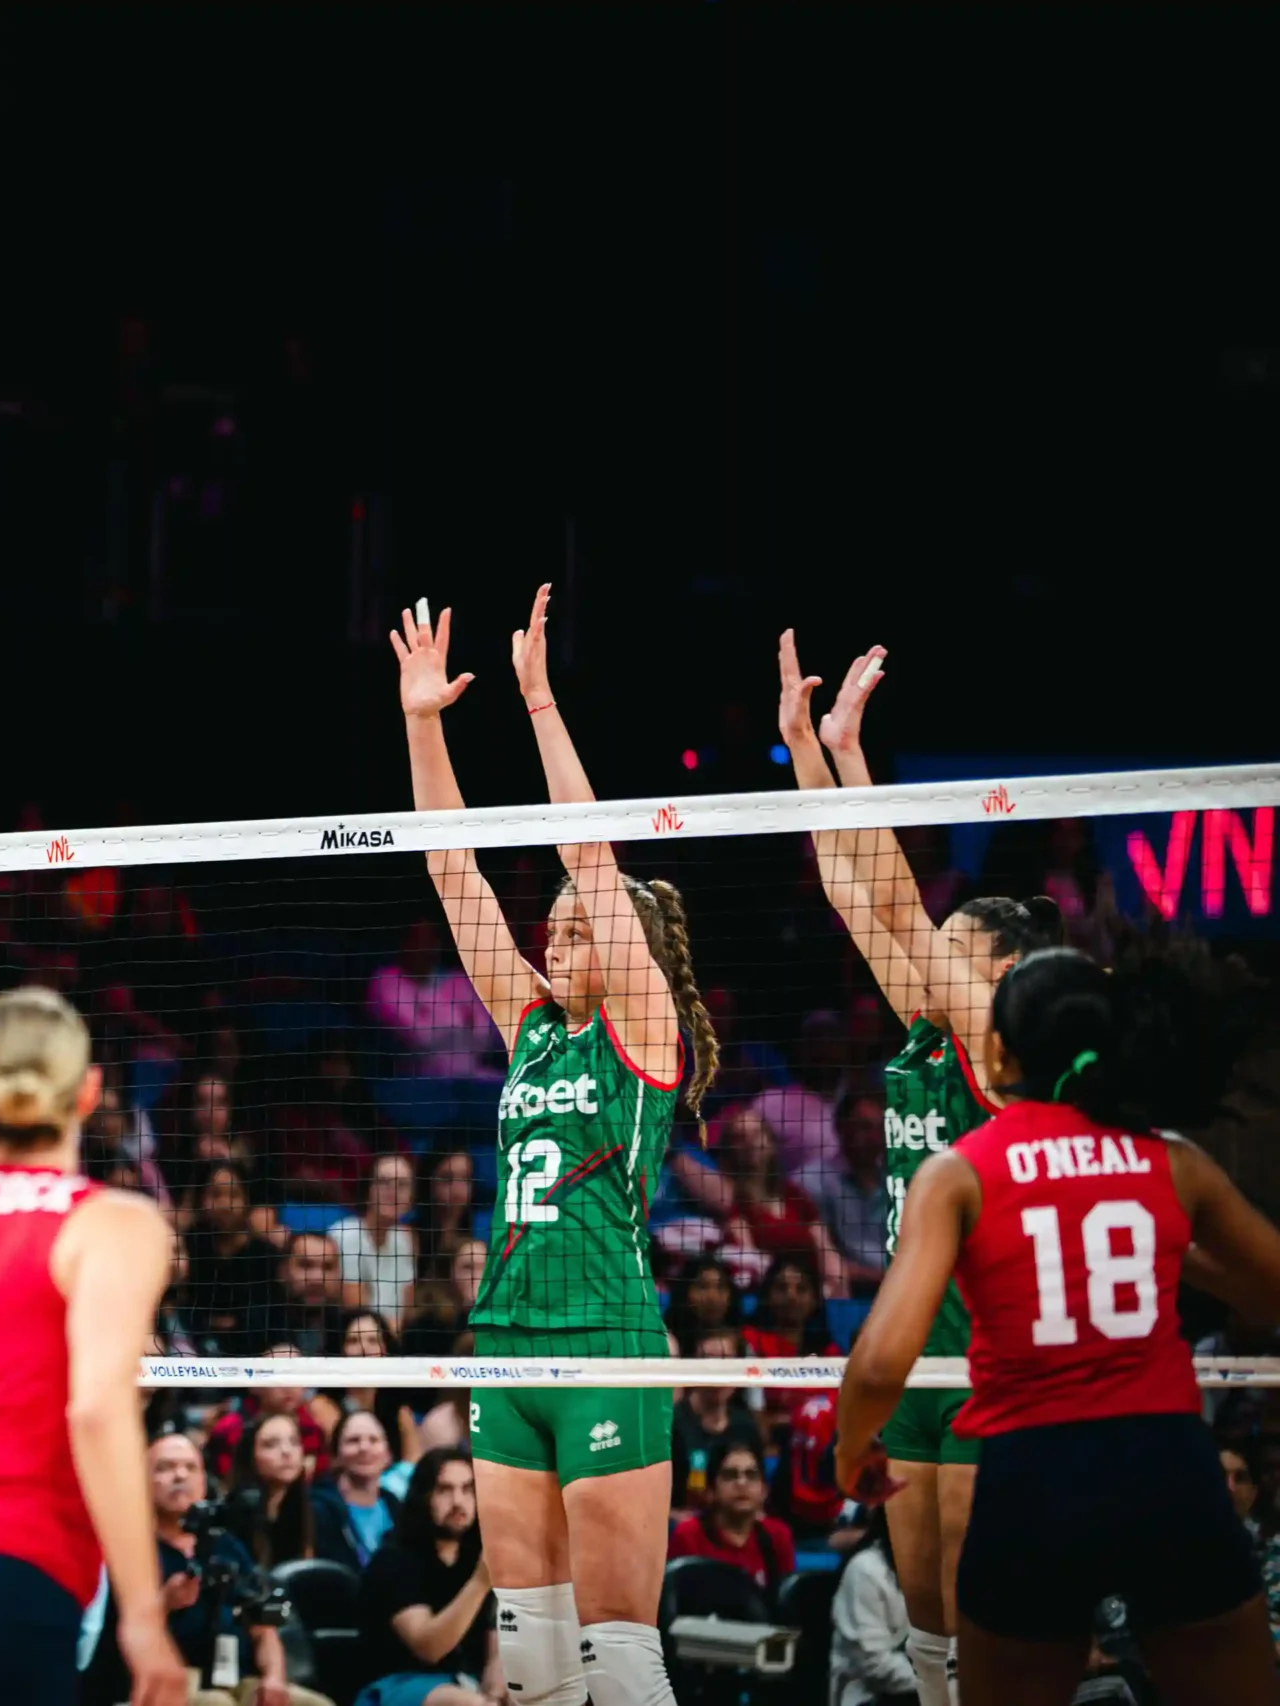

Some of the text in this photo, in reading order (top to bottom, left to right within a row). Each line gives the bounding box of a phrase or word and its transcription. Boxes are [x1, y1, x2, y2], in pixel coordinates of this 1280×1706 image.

[982, 784, 1015, 813] VNL
[652, 803, 684, 832] VNL
[47, 836, 74, 863] VNL
[320, 827, 395, 849] MIKASA
[1006, 1134, 1151, 1184] O'NEAL
[505, 1139, 562, 1222] 12
[1021, 1199, 1158, 1346] 18
[150, 1366, 218, 1378] VOLLEYBALL
[450, 1366, 521, 1378] VOLLEYBALL
